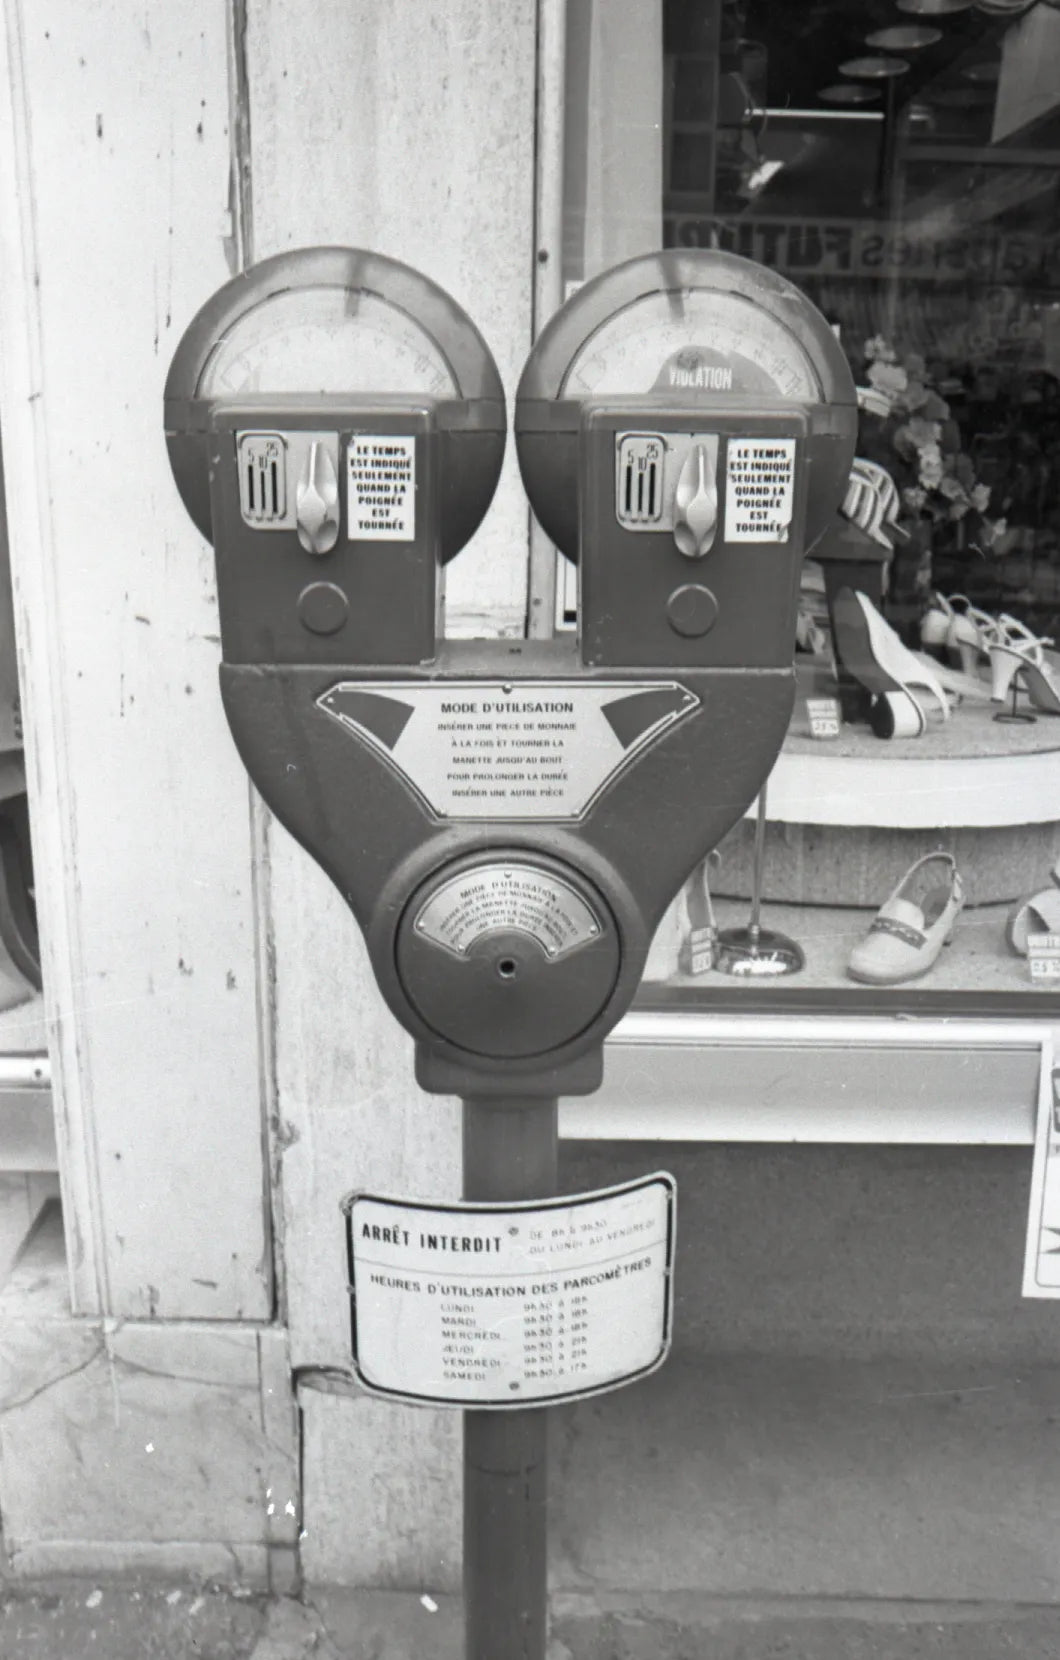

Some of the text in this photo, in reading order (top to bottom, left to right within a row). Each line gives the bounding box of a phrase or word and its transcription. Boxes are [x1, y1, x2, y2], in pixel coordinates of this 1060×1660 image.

[670, 366, 732, 389] VIOLATION
[356, 445, 406, 455] LE TEMPS
[737, 448, 787, 459] LE TEMPS
[627, 449, 634, 464] 5
[350, 456, 412, 469] EST INDIQUÉ
[730, 459, 792, 472] EST INDIQUÉ
[352, 471, 411, 481] SEULEMENT
[731, 474, 791, 483] SEULEMENT
[356, 483, 406, 494] QUAND LA
[735, 486, 785, 496] QUAND LA
[358, 494, 403, 506] POIGNÉE
[736, 496, 781, 509] POIGNÉE
[371, 508, 390, 517] EST
[750, 511, 768, 520] EST
[358, 518, 404, 530] TOURNÉE
[440, 702, 574, 714] MODE D'UTILISATION
[438, 720, 473, 731] INSÉRER
[476, 723, 493, 731] UNE
[523, 723, 534, 731] DE
[537, 723, 576, 731] MONNAIE
[511, 739, 550, 748] TOURNER
[553, 739, 564, 748] LA
[452, 756, 492, 764] MANETTE
[540, 756, 562, 764] BOUT
[447, 772, 470, 780] POUR
[472, 772, 525, 780] PROLONGER
[541, 769, 568, 781] DURÉE
[452, 785, 487, 797] INSÉRER
[489, 789, 506, 797] UNE
[510, 789, 536, 797] AUTRE
[362, 1222, 502, 1253] ARRÊT INTERDIT
[370, 1256, 652, 1298] HEURES D'UTILISATION DES PARCOMÈTRES
[441, 1316, 476, 1327] MARDI
[442, 1330, 500, 1340] MERCREDI
[442, 1357, 500, 1368] VENDREDI
